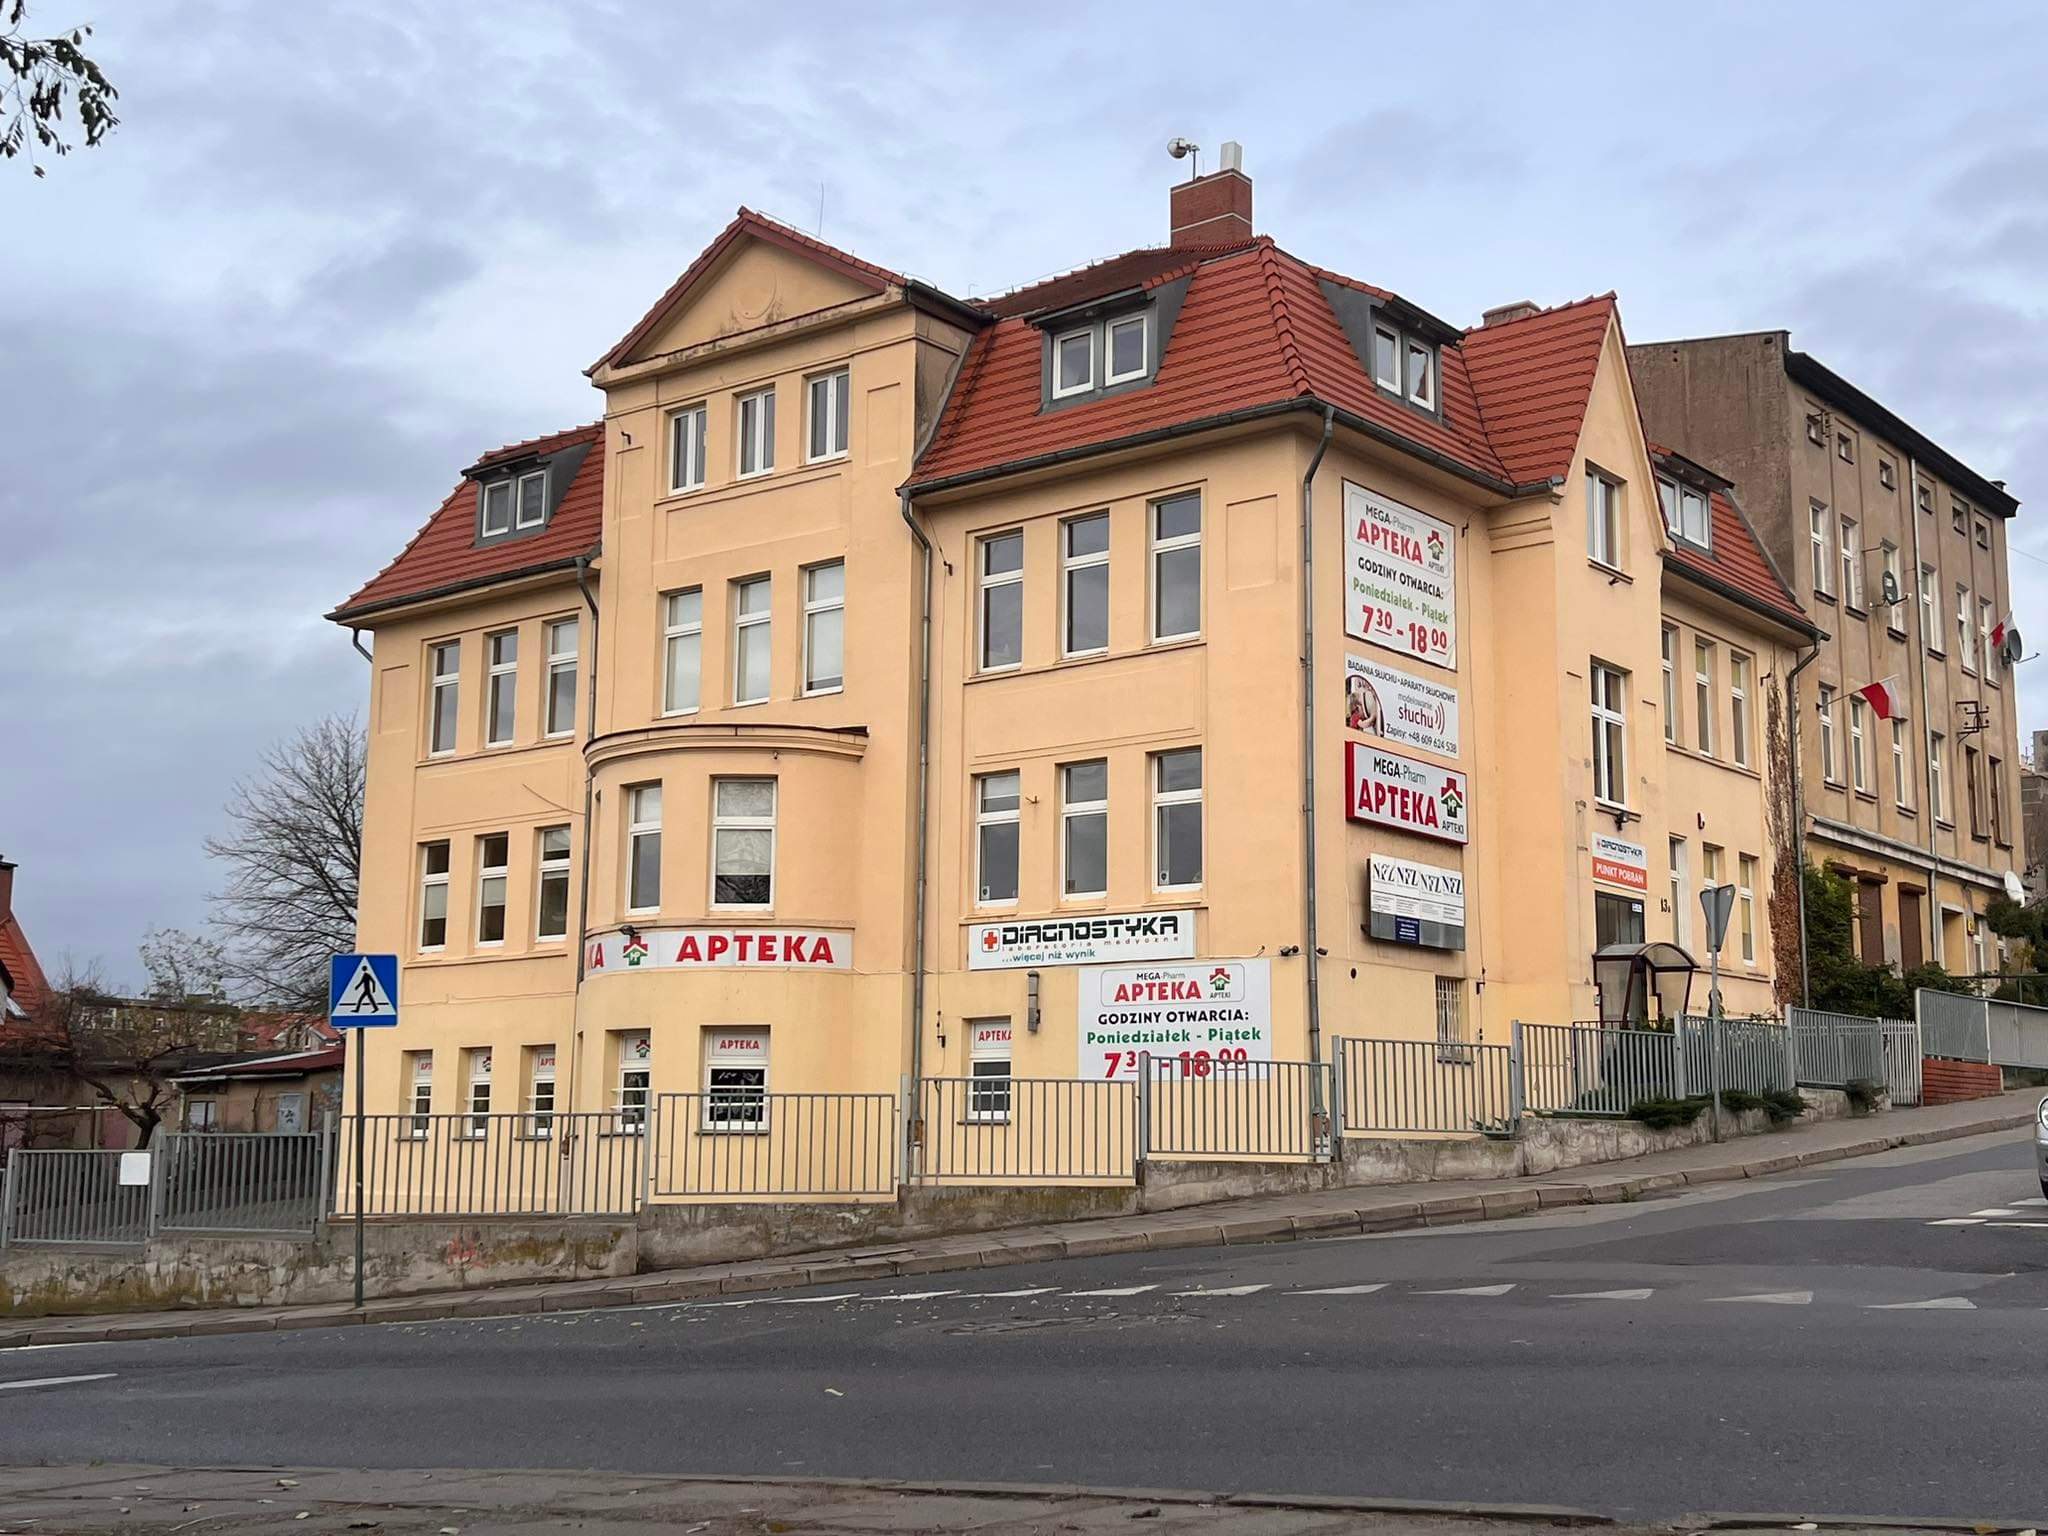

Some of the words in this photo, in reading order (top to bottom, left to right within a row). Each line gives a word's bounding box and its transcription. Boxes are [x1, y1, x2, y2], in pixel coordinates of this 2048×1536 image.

[1357, 519, 1423, 565] APTEKA
[1358, 557, 1397, 582] GODZINY
[1400, 572, 1444, 599] OTWARCIA:
[1353, 577, 1414, 612] Poniedziałek
[1421, 602, 1449, 625] Piątek
[1348, 659, 1374, 678] BADANIA
[1374, 668, 1398, 684] SŁUCHU
[1400, 677, 1425, 694] APARATY
[1425, 686, 1456, 704] SŁUCHOWE
[1398, 704, 1434, 729] słuchu
[1408, 730, 1420, 743] +48
[1358, 778, 1439, 829] APTEKA
[1596, 862, 1618, 878] PUNKT
[676, 935, 834, 963] APTEKA
[1048, 950, 1063, 960] niż
[1065, 949, 1096, 960] wynik
[1114, 980, 1202, 1002] APTEKA
[1098, 1011, 1162, 1025] GODZINY
[1166, 1009, 1249, 1023] OTWARCIA:
[719, 1039, 760, 1050] APTEKA
[1087, 1029, 1191, 1045] Poniedziałek
[1208, 1027, 1261, 1045] Piątek
